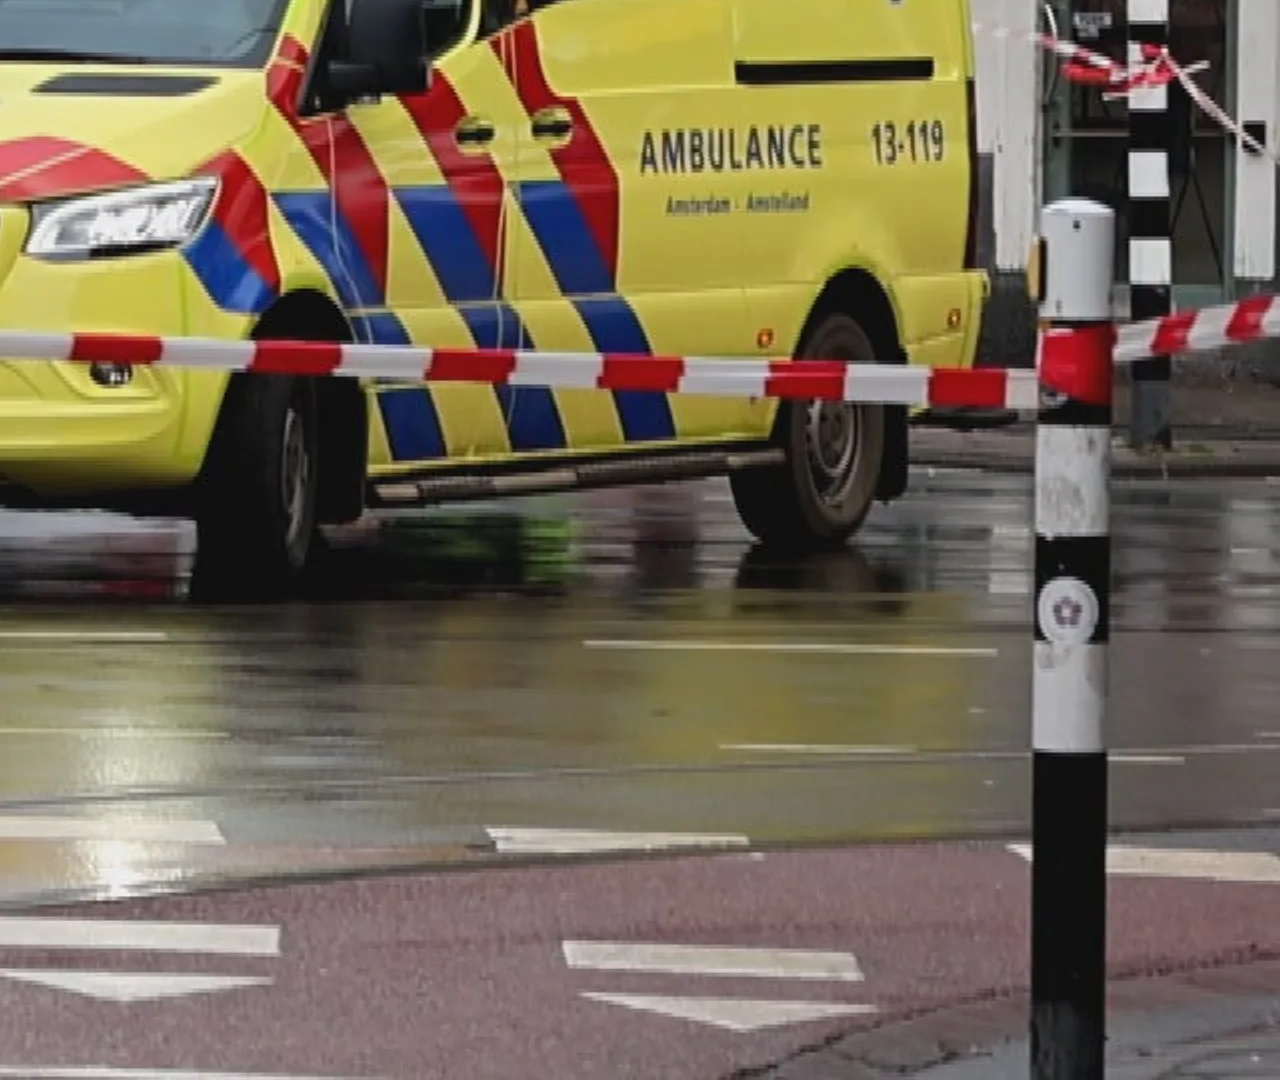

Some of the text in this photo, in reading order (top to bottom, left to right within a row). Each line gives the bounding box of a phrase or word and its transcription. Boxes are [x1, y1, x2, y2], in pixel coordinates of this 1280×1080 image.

[640, 124, 823, 174] AMBULANCE
[872, 120, 944, 165] 13-119
[666, 195, 731, 216] Amsterdam
[746, 190, 810, 212] Amstelland
